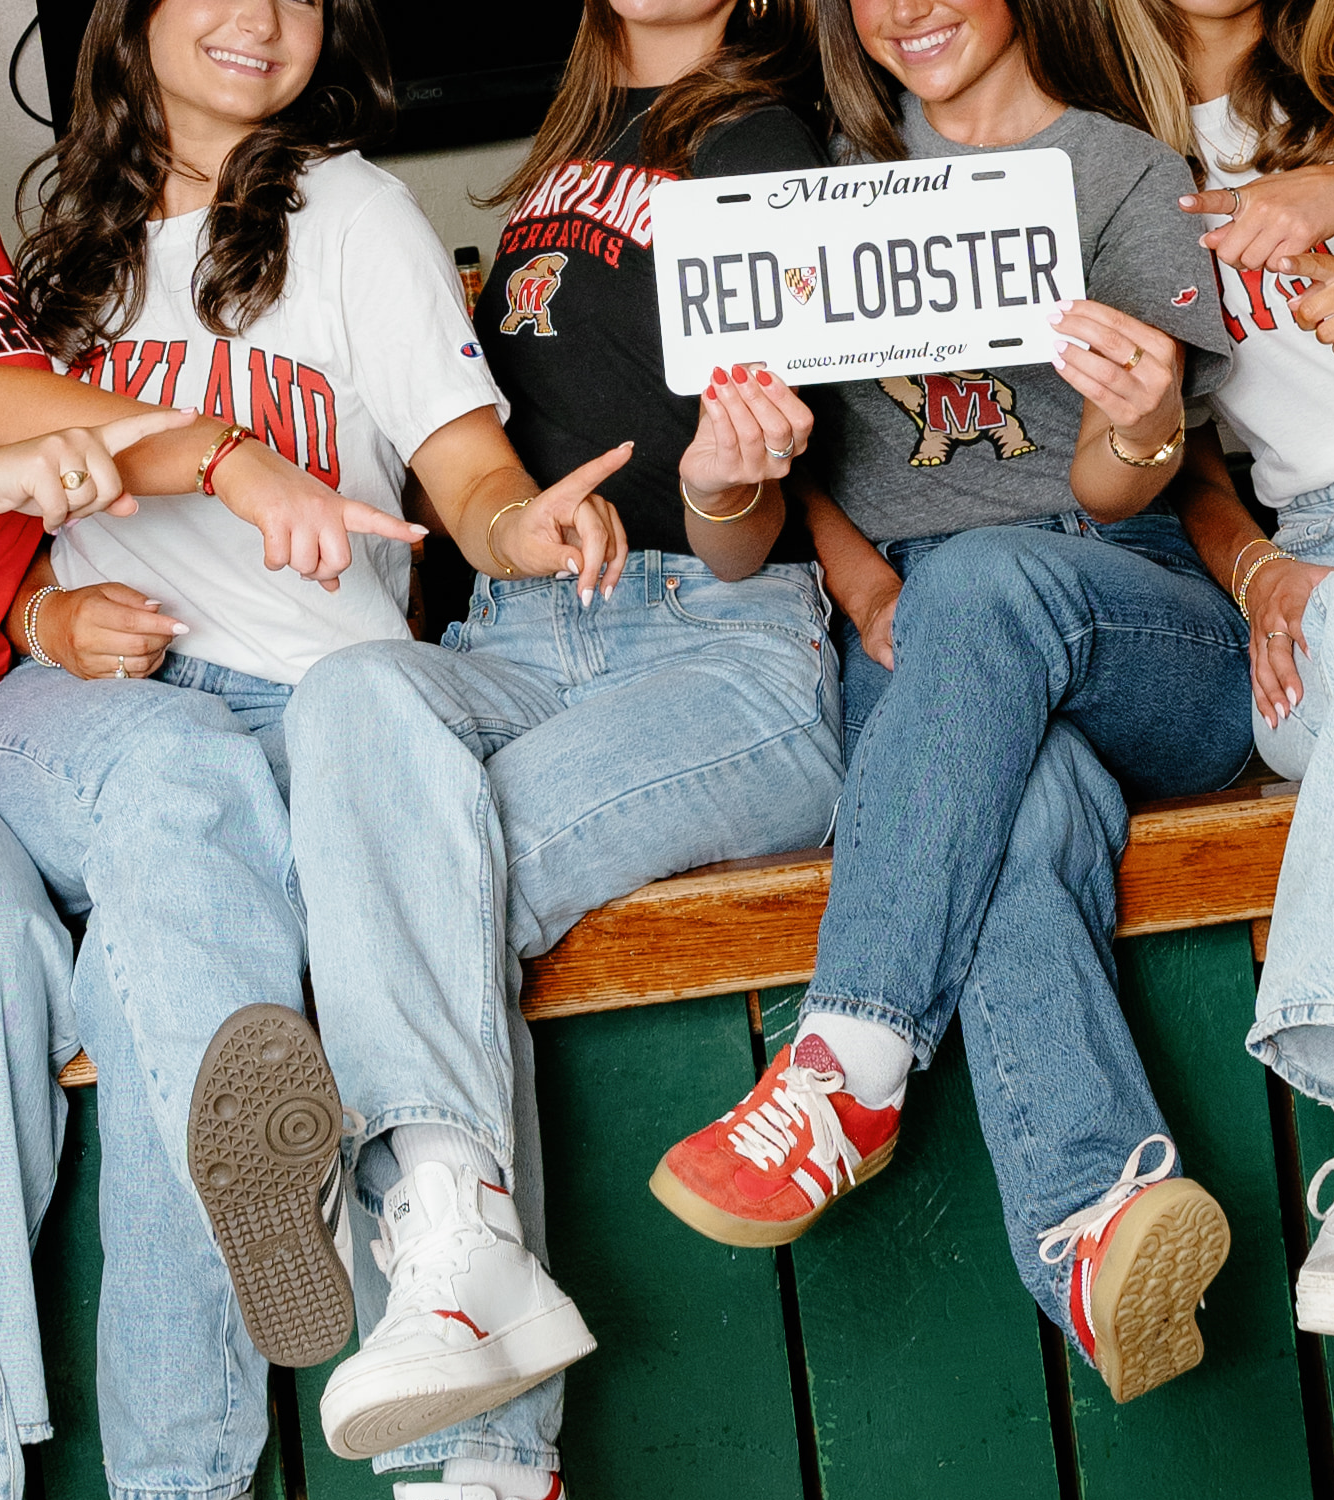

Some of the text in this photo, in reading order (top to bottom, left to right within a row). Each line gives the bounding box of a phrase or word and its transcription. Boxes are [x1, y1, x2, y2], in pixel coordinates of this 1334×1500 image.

[767, 164, 952, 209] Maryland
[677, 225, 1061, 337] RED LOBSTER
[787, 342, 968, 372] www.maryland.gov
